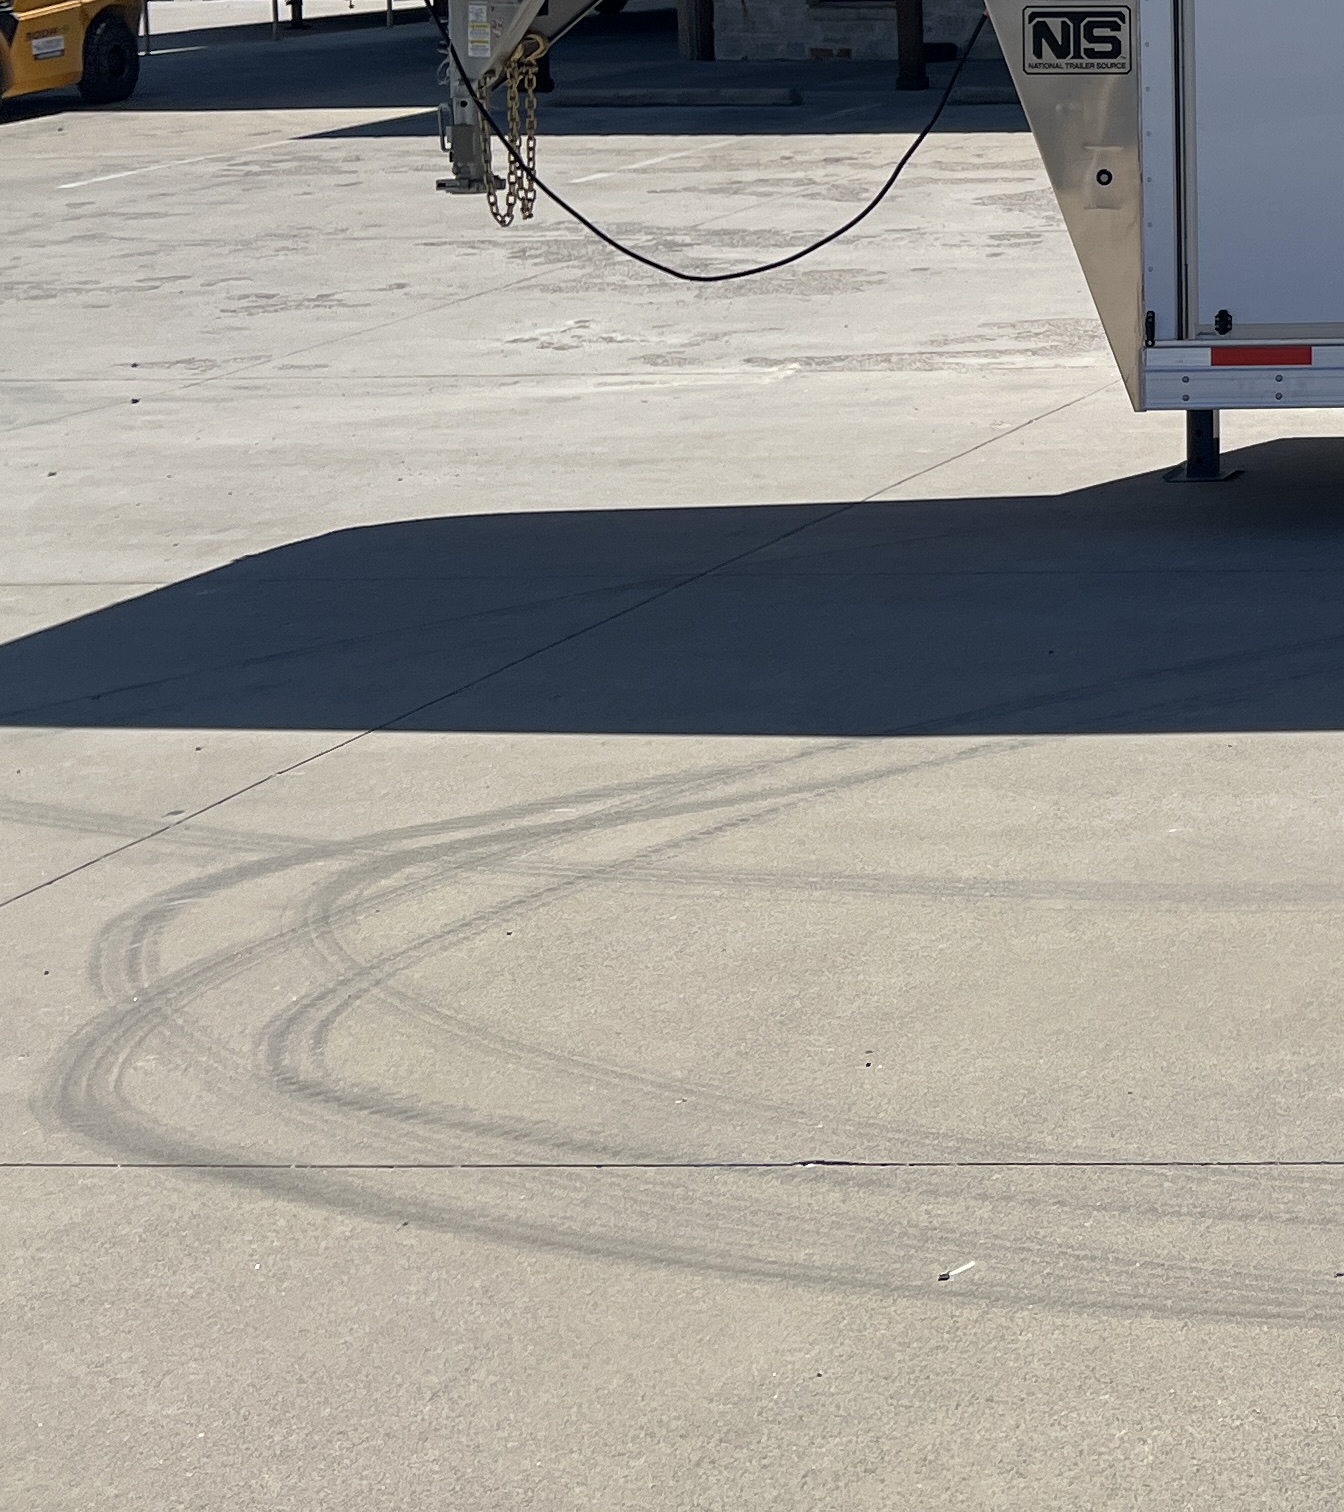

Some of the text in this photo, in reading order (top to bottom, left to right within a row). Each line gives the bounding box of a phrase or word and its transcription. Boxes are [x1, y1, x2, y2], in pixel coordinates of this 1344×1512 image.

[1028, 11, 1126, 60] NTS
[1028, 62, 1127, 70] NATIONAL TRAILER SOURCE
